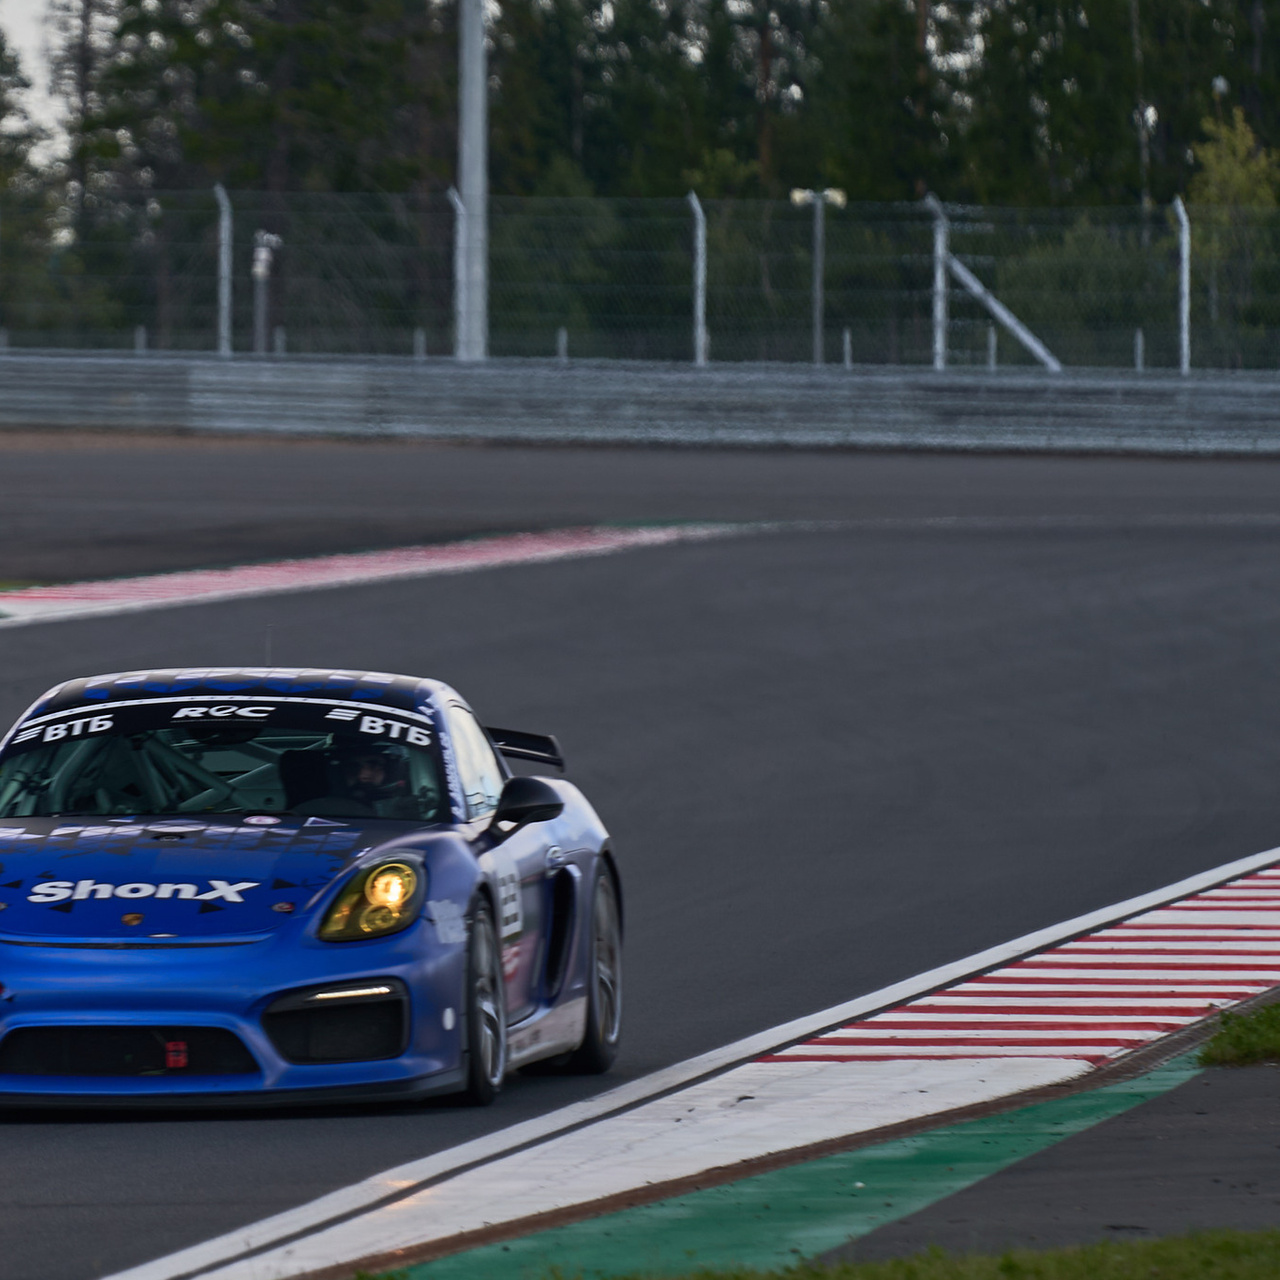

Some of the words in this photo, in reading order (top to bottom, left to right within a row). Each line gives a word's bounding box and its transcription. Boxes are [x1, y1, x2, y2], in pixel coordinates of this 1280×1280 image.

[42, 713, 115, 742] ВТБ
[359, 715, 432, 746] ВТБ
[27, 879, 262, 903] ShonX
